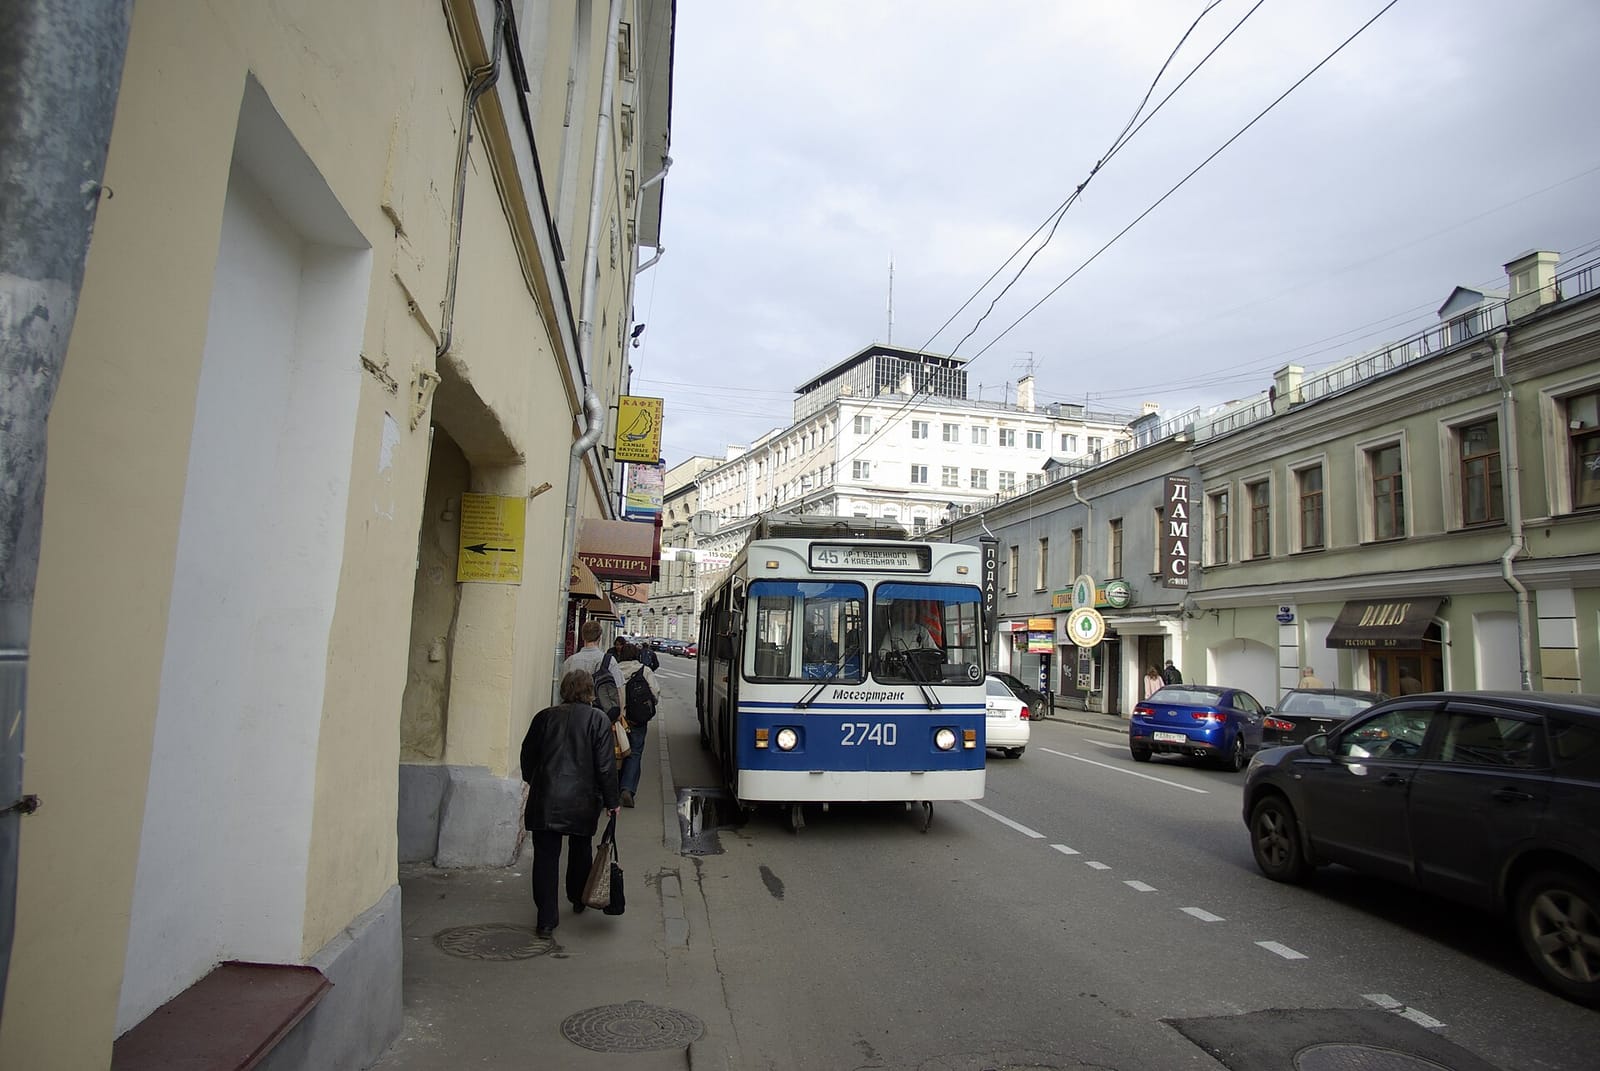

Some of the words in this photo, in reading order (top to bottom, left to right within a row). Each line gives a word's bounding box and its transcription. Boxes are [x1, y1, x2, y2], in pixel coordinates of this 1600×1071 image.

[652, 400, 662, 461] ЧЕБУРЕЧКА
[1169, 484, 1189, 576] ДАМАС
[580, 556, 648, 571] ТРАКТИРЪ
[818, 550, 838, 564] 45
[864, 551, 908, 559] БУДЕННОГО
[851, 558, 895, 566] КАБЕЛЬНАЯ
[1358, 603, 1411, 627] DAMAS
[1345, 639, 1377, 647] РЕСТОРАН
[1384, 639, 1397, 647] БАР
[832, 689, 905, 702] Мосгортранс
[841, 723, 897, 746] 2740
